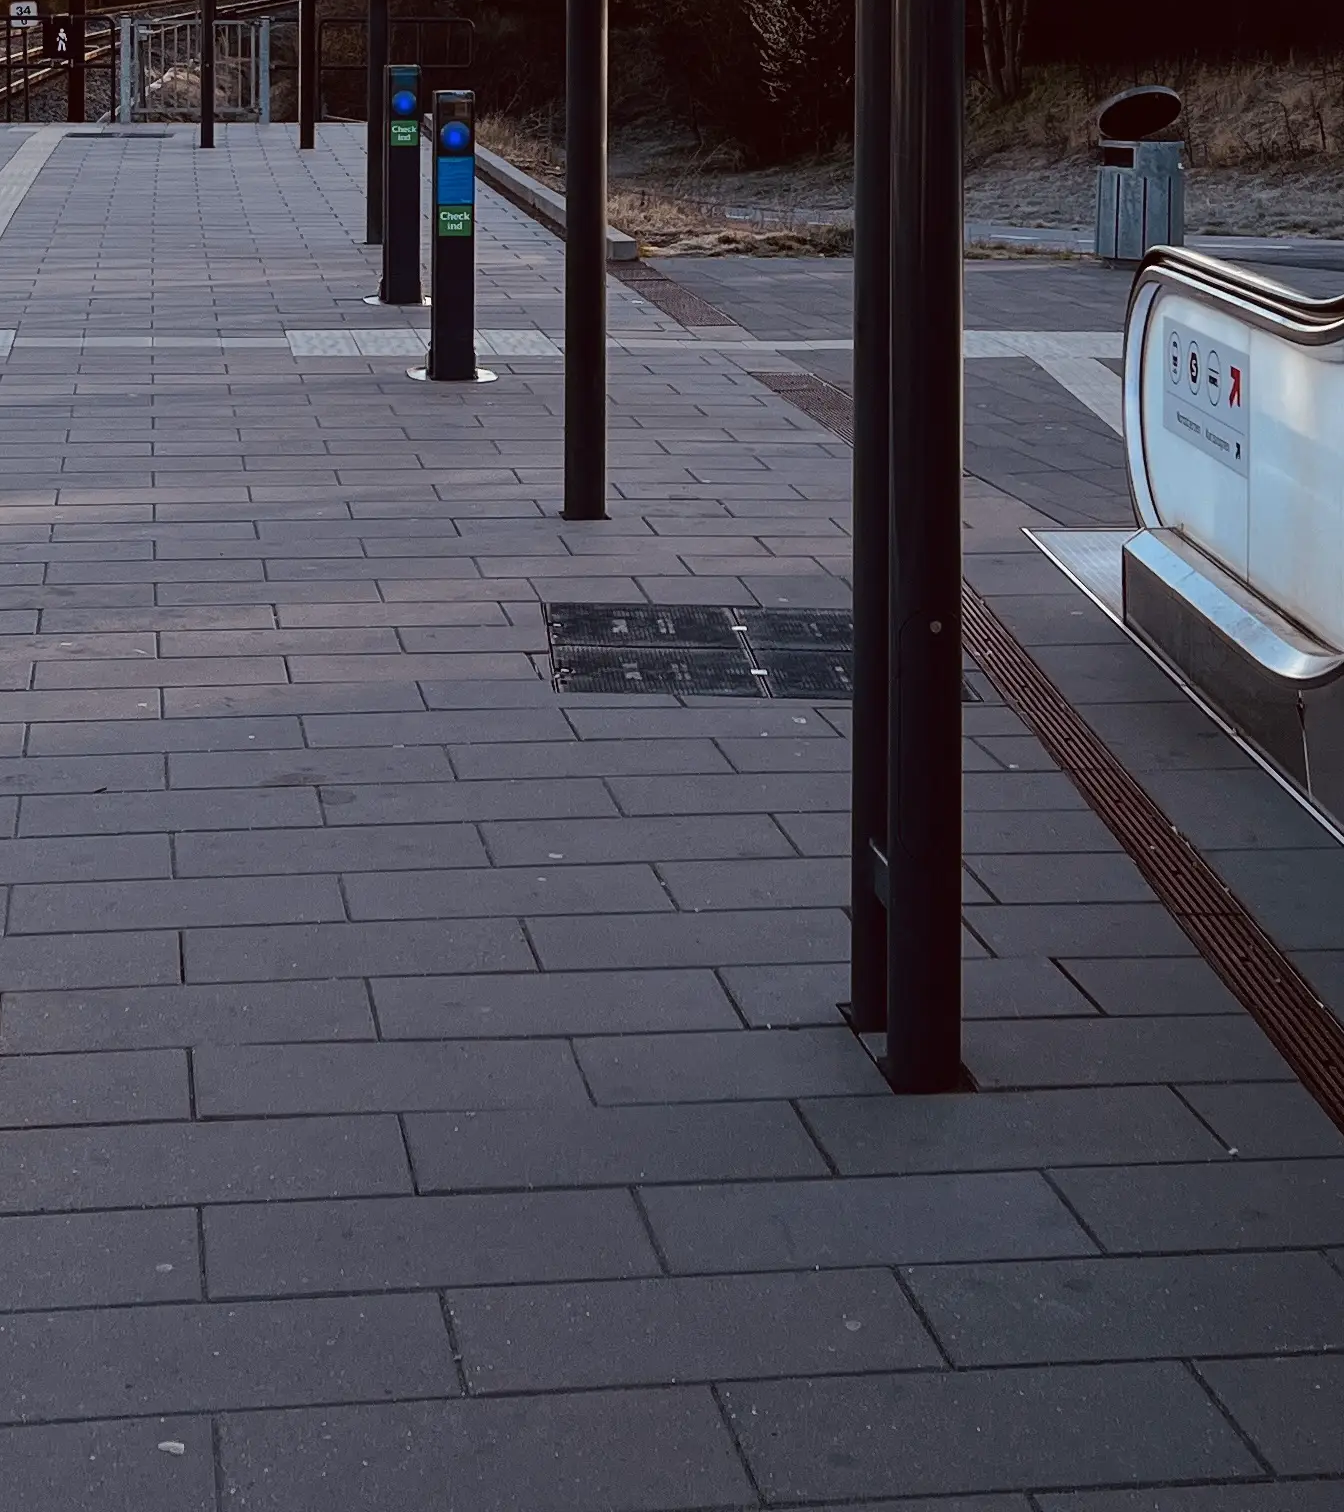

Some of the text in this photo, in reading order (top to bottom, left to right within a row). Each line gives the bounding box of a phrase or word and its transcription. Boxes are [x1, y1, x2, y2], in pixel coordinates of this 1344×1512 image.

[16, 5, 31, 16] 34
[391, 125, 417, 134] Check
[439, 211, 471, 221] Check
[447, 221, 463, 231] ind
